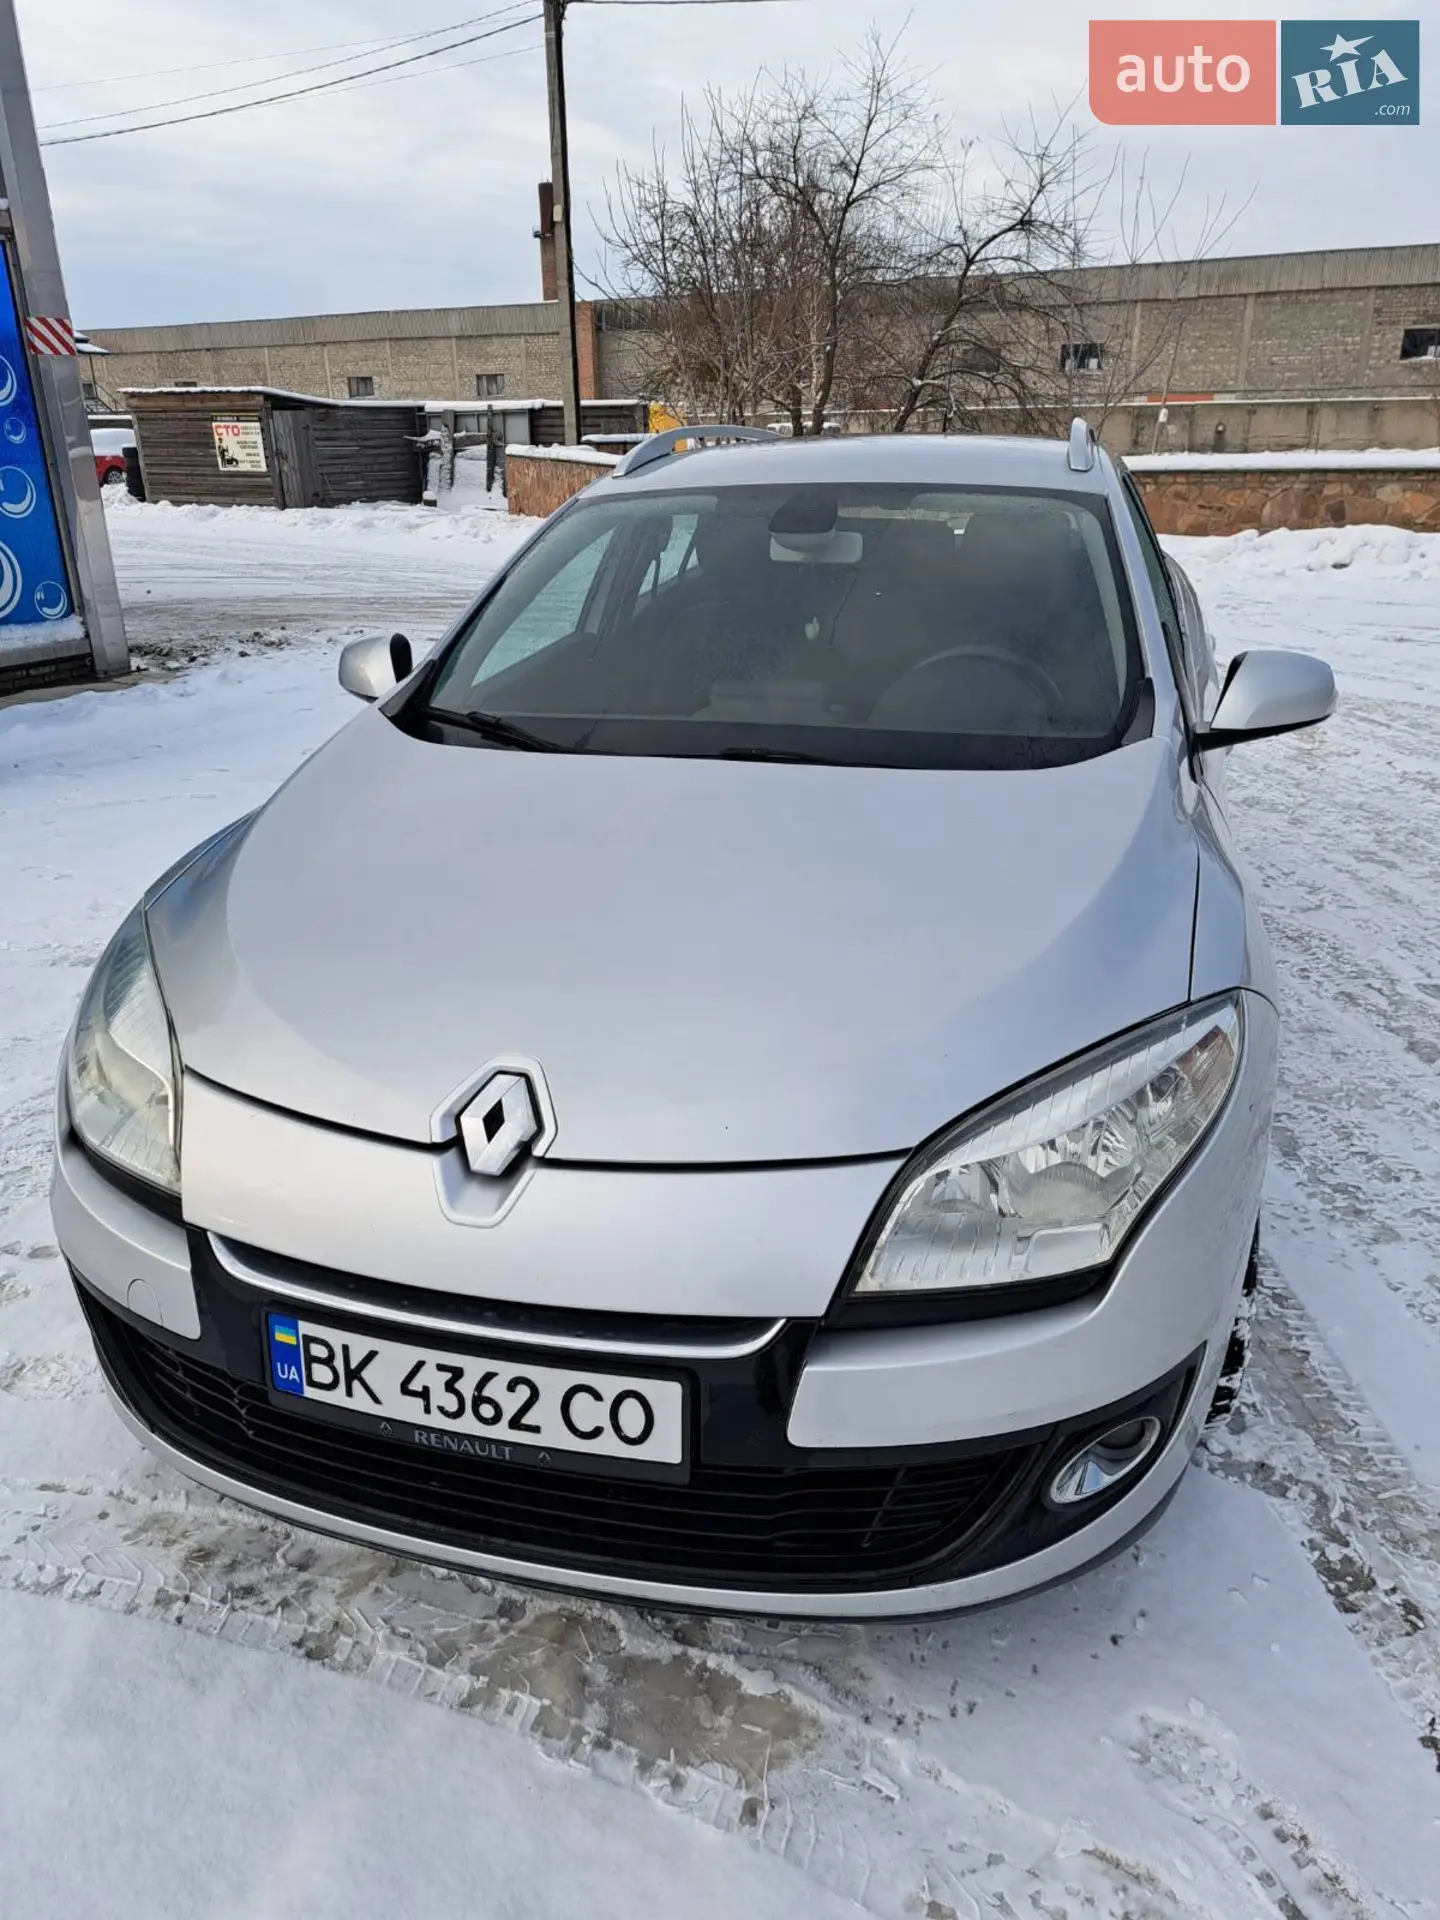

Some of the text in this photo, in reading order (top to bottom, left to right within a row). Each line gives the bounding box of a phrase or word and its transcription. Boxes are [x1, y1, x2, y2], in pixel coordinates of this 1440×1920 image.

[277, 1361, 299, 1382] UA
[301, 1333, 655, 1447] BK 4362 CO
[413, 1429, 515, 1462] RENAULT
